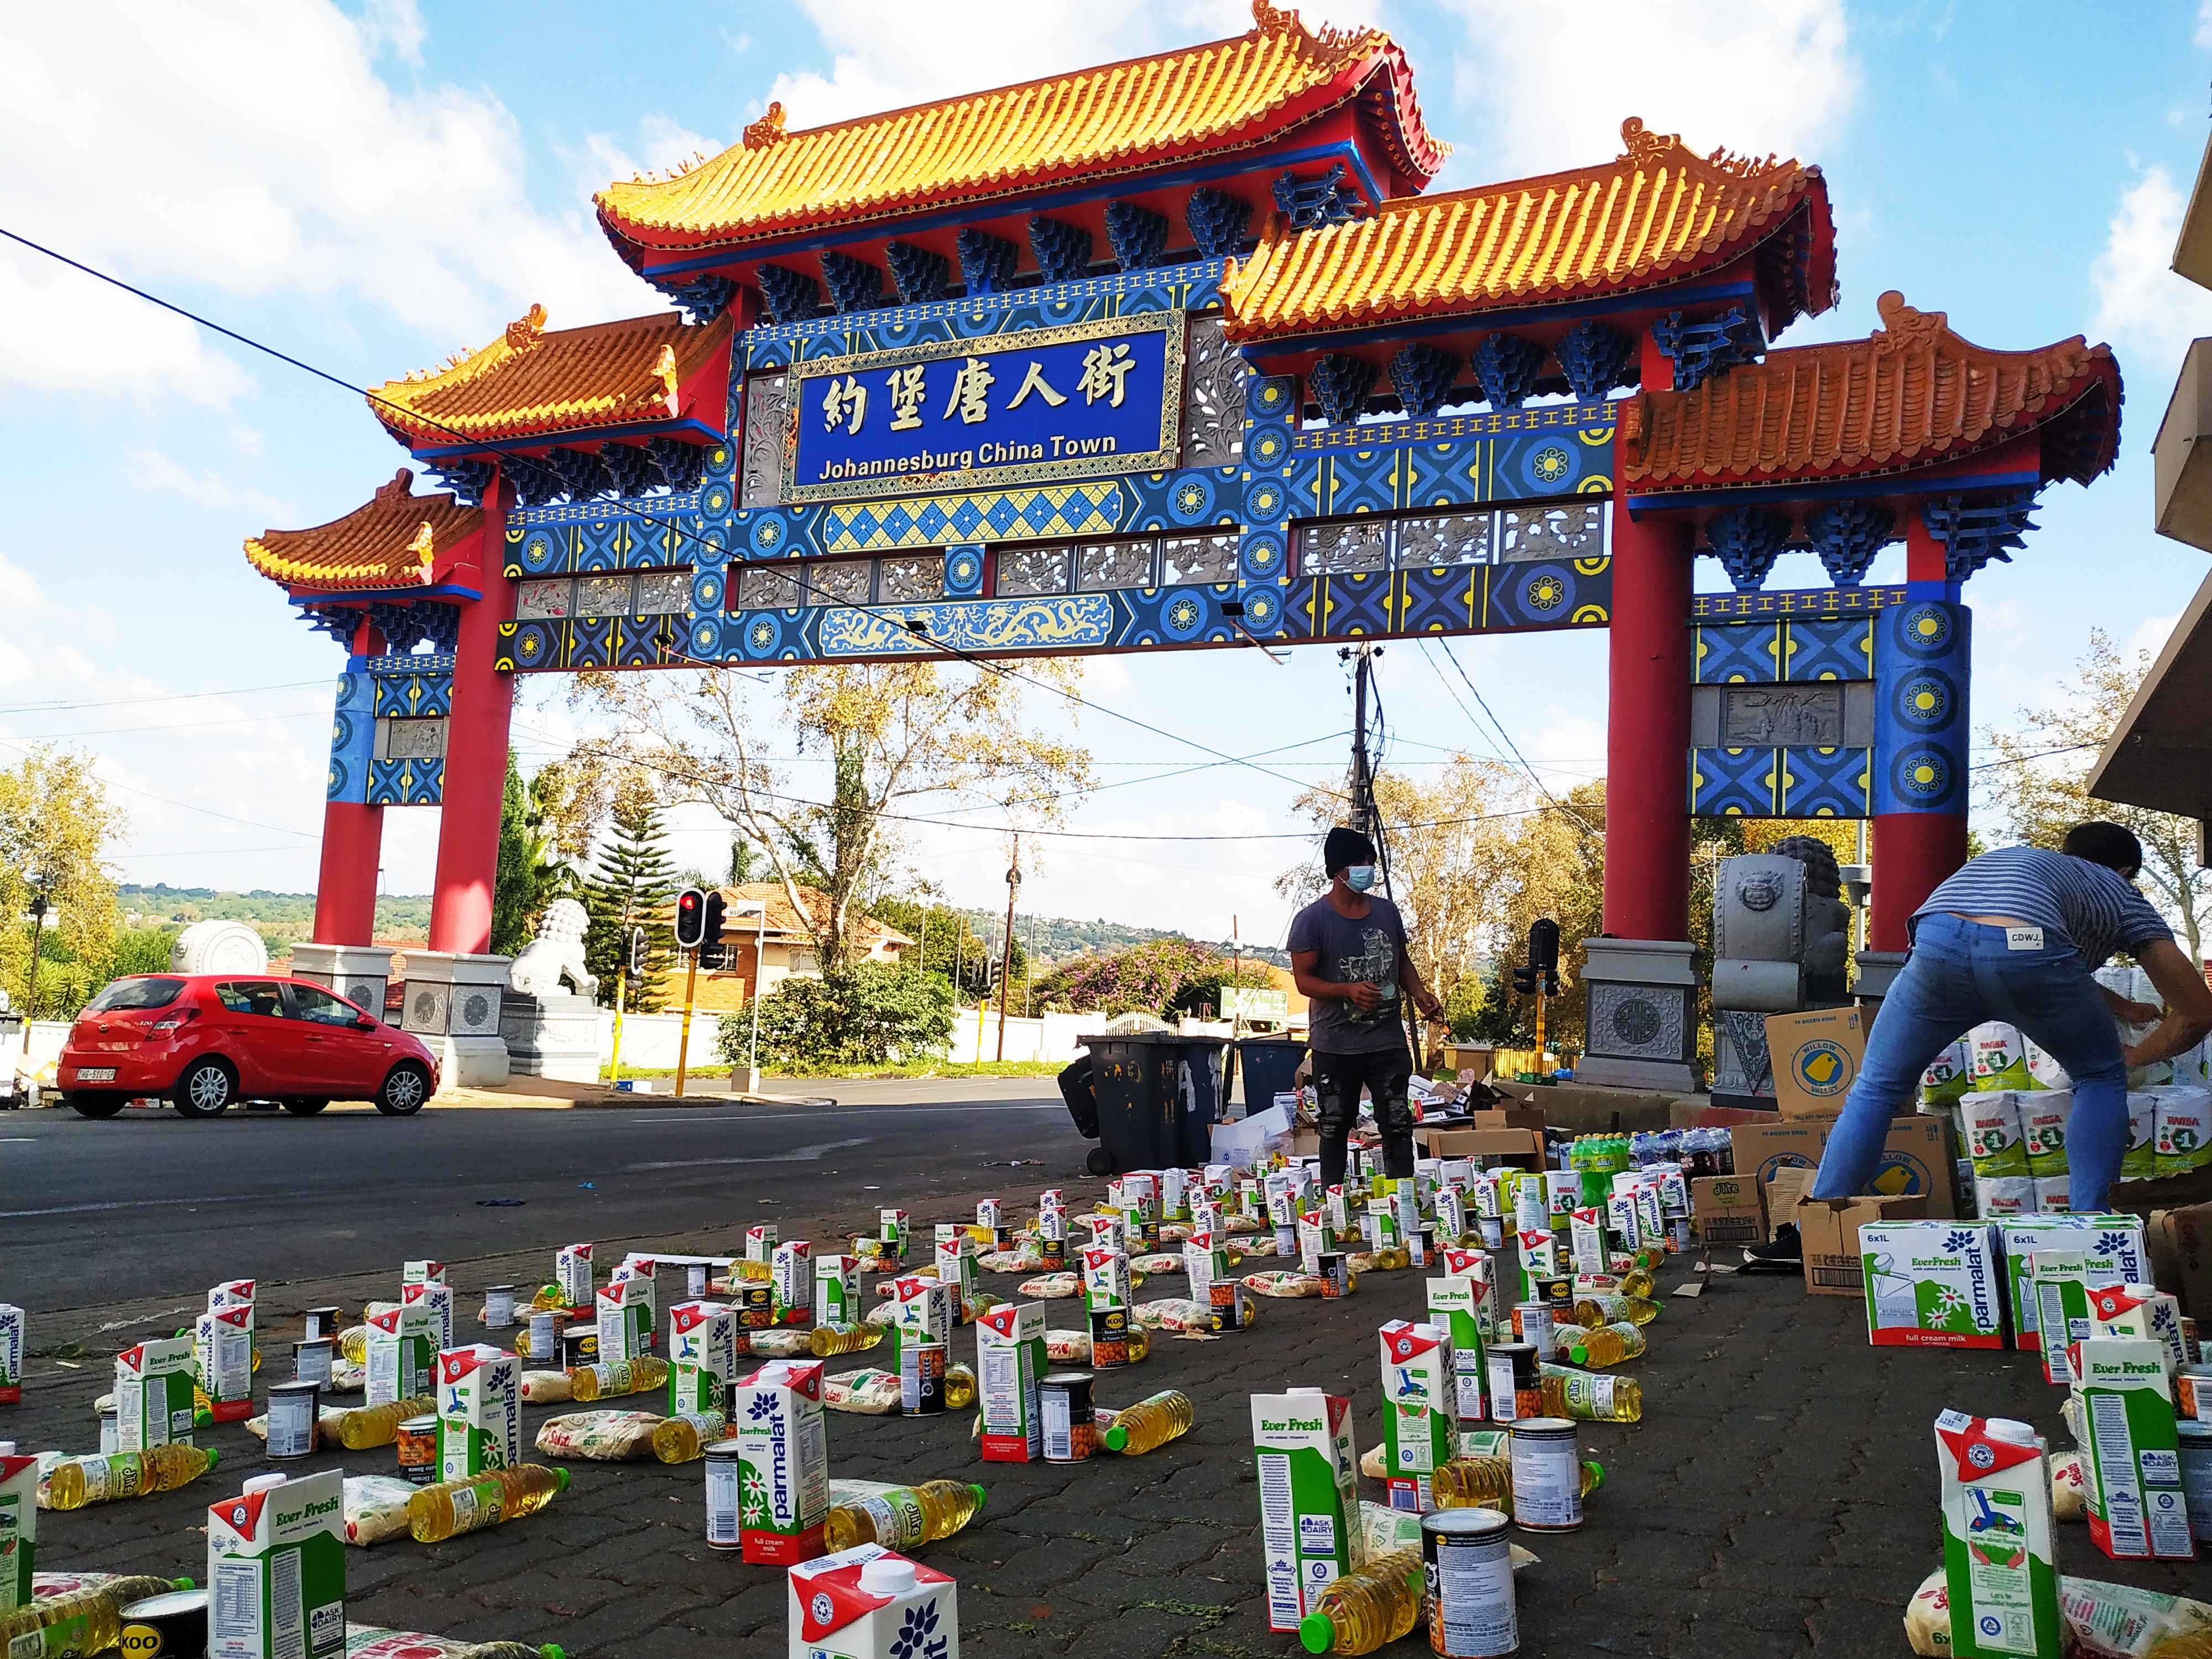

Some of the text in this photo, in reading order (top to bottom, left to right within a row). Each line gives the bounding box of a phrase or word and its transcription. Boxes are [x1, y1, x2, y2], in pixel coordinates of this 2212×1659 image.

[822, 343, 1136, 435] 約堡唐人街
[819, 435, 1116, 480] Johannesburg China Town
[1803, 1042, 1837, 1054] WILLOW
[1980, 1040, 2007, 1050] IWISA
[1811, 1084, 1838, 1094] VALLEY
[1975, 1118, 2005, 1128] IWISA
[2032, 1115, 2063, 1125] IWISA
[2167, 1116, 2200, 1126] IWISA
[1883, 1154, 1912, 1164] LLOW
[1677, 1185, 1686, 1205] malat
[1714, 1183, 1739, 1195] d'lite
[1991, 1198, 2021, 1207] IWISA
[2046, 1196, 2069, 1204] IWIS
[1449, 1201, 1458, 1235] parmalat
[1648, 1197, 1661, 1234] parmalat
[1625, 1208, 1637, 1249] parmalat
[1867, 1234, 1890, 1243] 6x1L
[2013, 1235, 2038, 1244] 6x1L
[1911, 1257, 1961, 1266] EverFresh
[2058, 1263, 2083, 1271] Fresh
[2085, 1259, 2114, 1269] Fresh
[2118, 1249, 2140, 1284] alat
[1965, 1246, 1995, 1328] parmalat
[441, 1302, 450, 1349] armalat
[1031, 1317, 1044, 1327] Fresh
[8, 1324, 19, 1380] parmalat
[149, 1351, 190, 1365] Ever Fresh
[723, 1332, 734, 1378] malat
[2092, 1362, 2161, 1374] Ever Fresh
[618, 1365, 629, 1385] d'lite
[825, 1391, 843, 1402] elati
[1568, 1379, 1581, 1404] d'lite
[1261, 1418, 1323, 1431] Ever Fresh
[739, 1427, 772, 1436] EverFresh
[769, 1413, 792, 1519] parmalat
[123, 1468, 139, 1493] d'lite
[275, 1496, 339, 1527] Ever Fresh
[905, 1503, 922, 1536] d'lite
[324, 1607, 340, 1616] ASK
[318, 1613, 342, 1627] DAIRY
[122, 1636, 158, 1650] KOO
